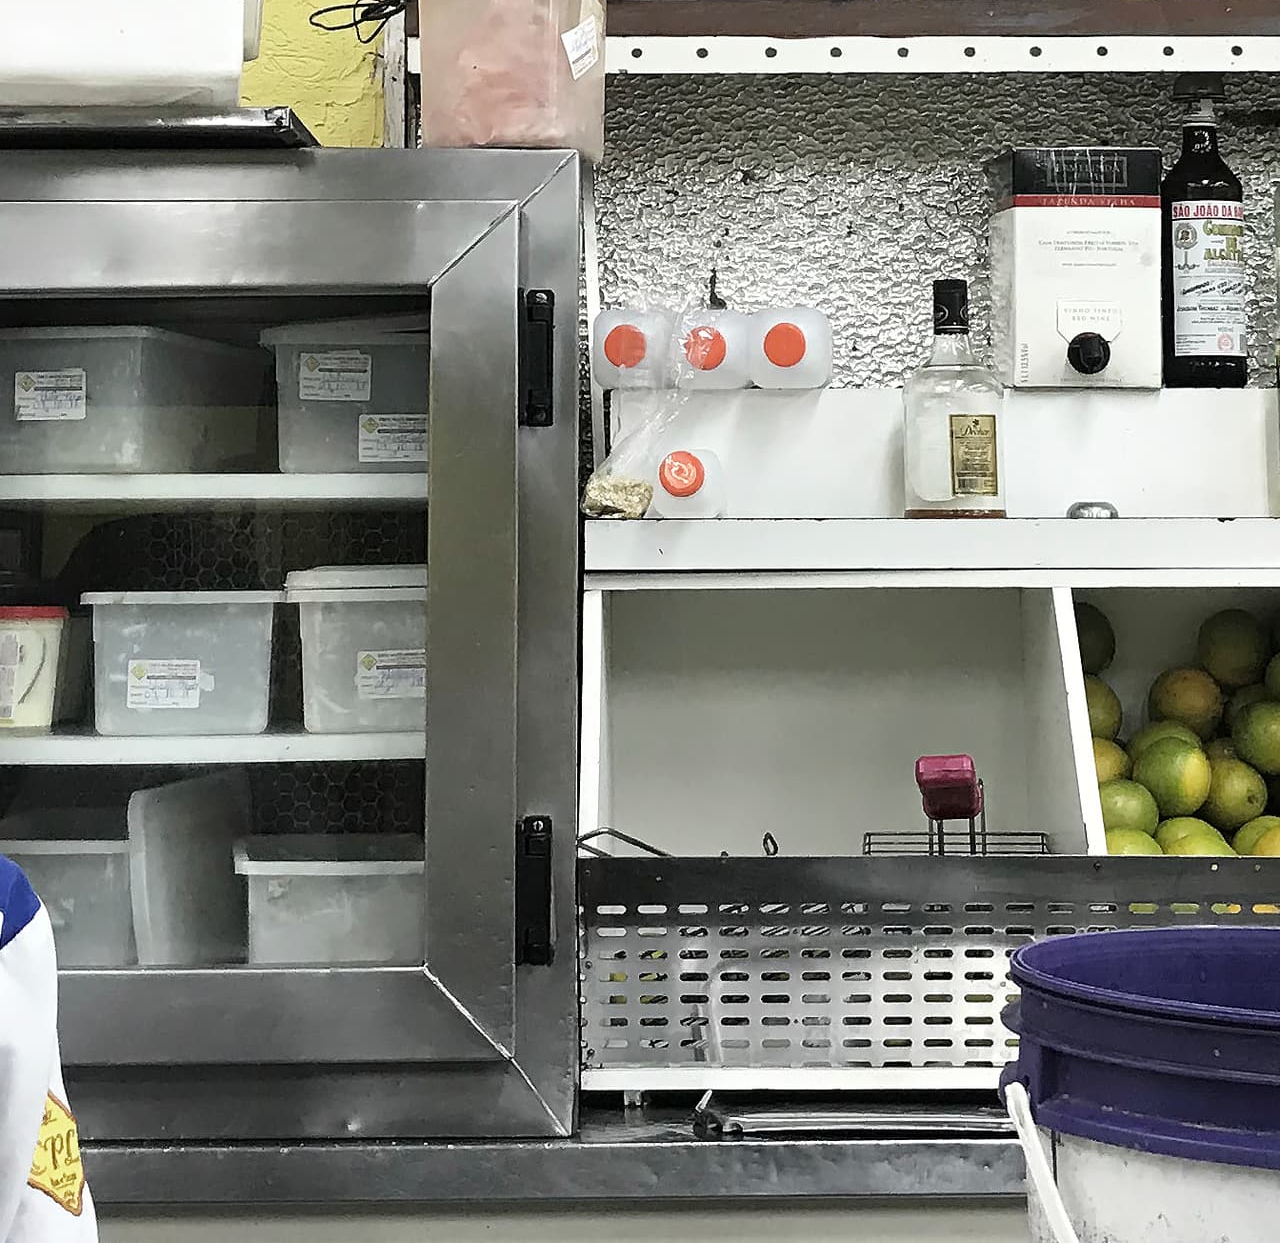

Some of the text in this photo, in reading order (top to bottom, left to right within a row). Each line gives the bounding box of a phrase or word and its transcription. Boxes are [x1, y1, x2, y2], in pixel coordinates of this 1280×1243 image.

[1173, 204, 1190, 218] SÃO
[1193, 203, 1219, 217] JOÃO
[1222, 205, 1233, 217] DA
